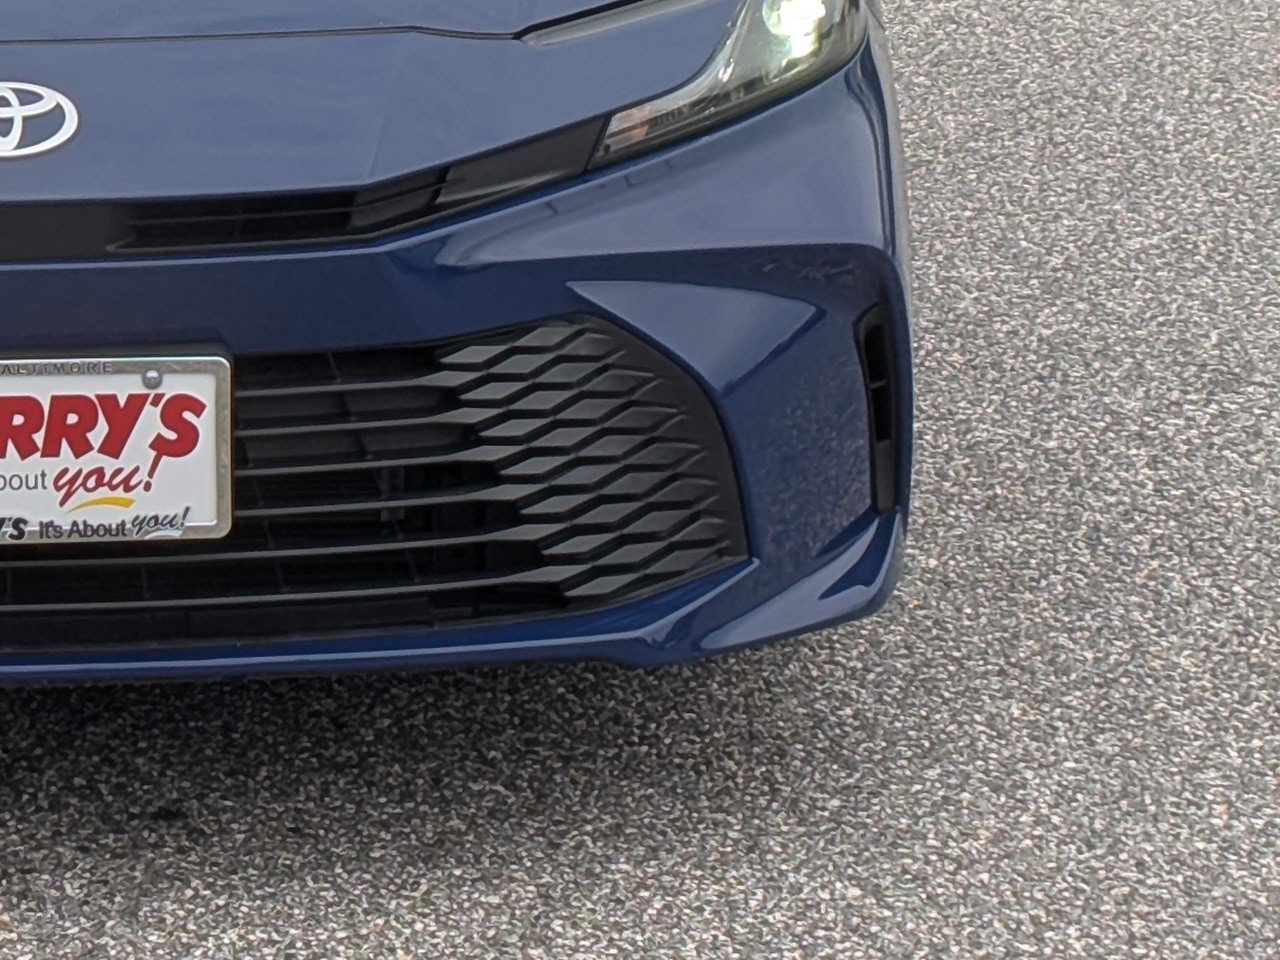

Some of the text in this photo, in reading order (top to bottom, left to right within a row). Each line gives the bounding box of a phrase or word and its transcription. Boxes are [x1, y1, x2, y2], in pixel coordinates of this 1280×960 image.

[52, 453, 163, 508] you!
[38, 520, 64, 539] It's
[67, 519, 128, 538] About
[131, 506, 191, 536] you!
